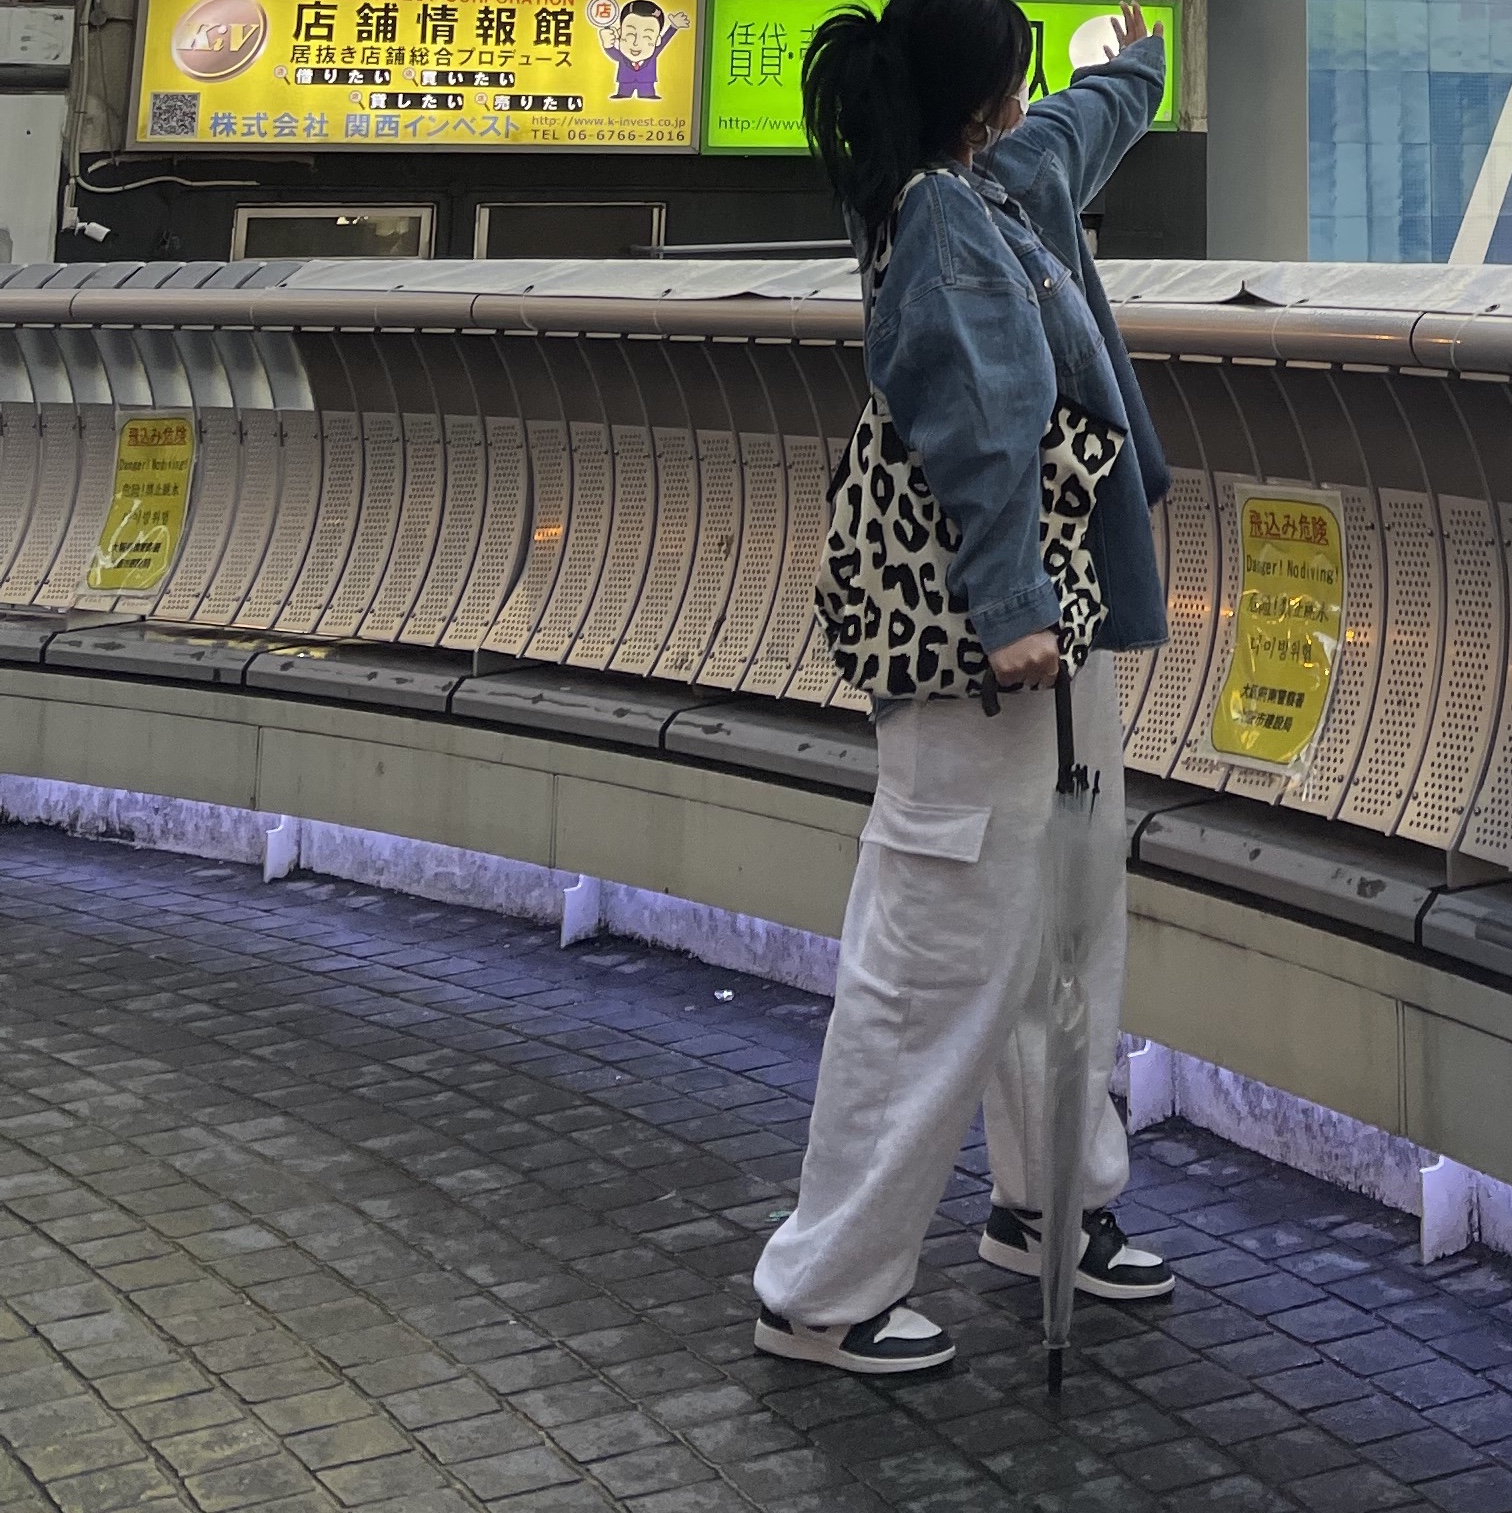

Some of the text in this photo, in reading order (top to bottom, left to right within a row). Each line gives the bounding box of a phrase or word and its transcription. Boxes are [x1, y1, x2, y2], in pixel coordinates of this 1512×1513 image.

[595, 3, 611, 18] 店
[292, 0, 574, 47] 店舗情報館
[290, 45, 573, 67] 居抜き店舗総合プロデュース
[296, 68, 390, 84] 借りたい
[421, 70, 515, 87] 買いたい
[370, 93, 463, 109] 貸したい
[494, 95, 583, 111] 売りたい
[209, 112, 520, 139] 株式会社 関西インベスト
[531, 115, 686, 129] http://www.k-invest.co.jp
[531, 129, 685, 142] TEL 06-6766-2016
